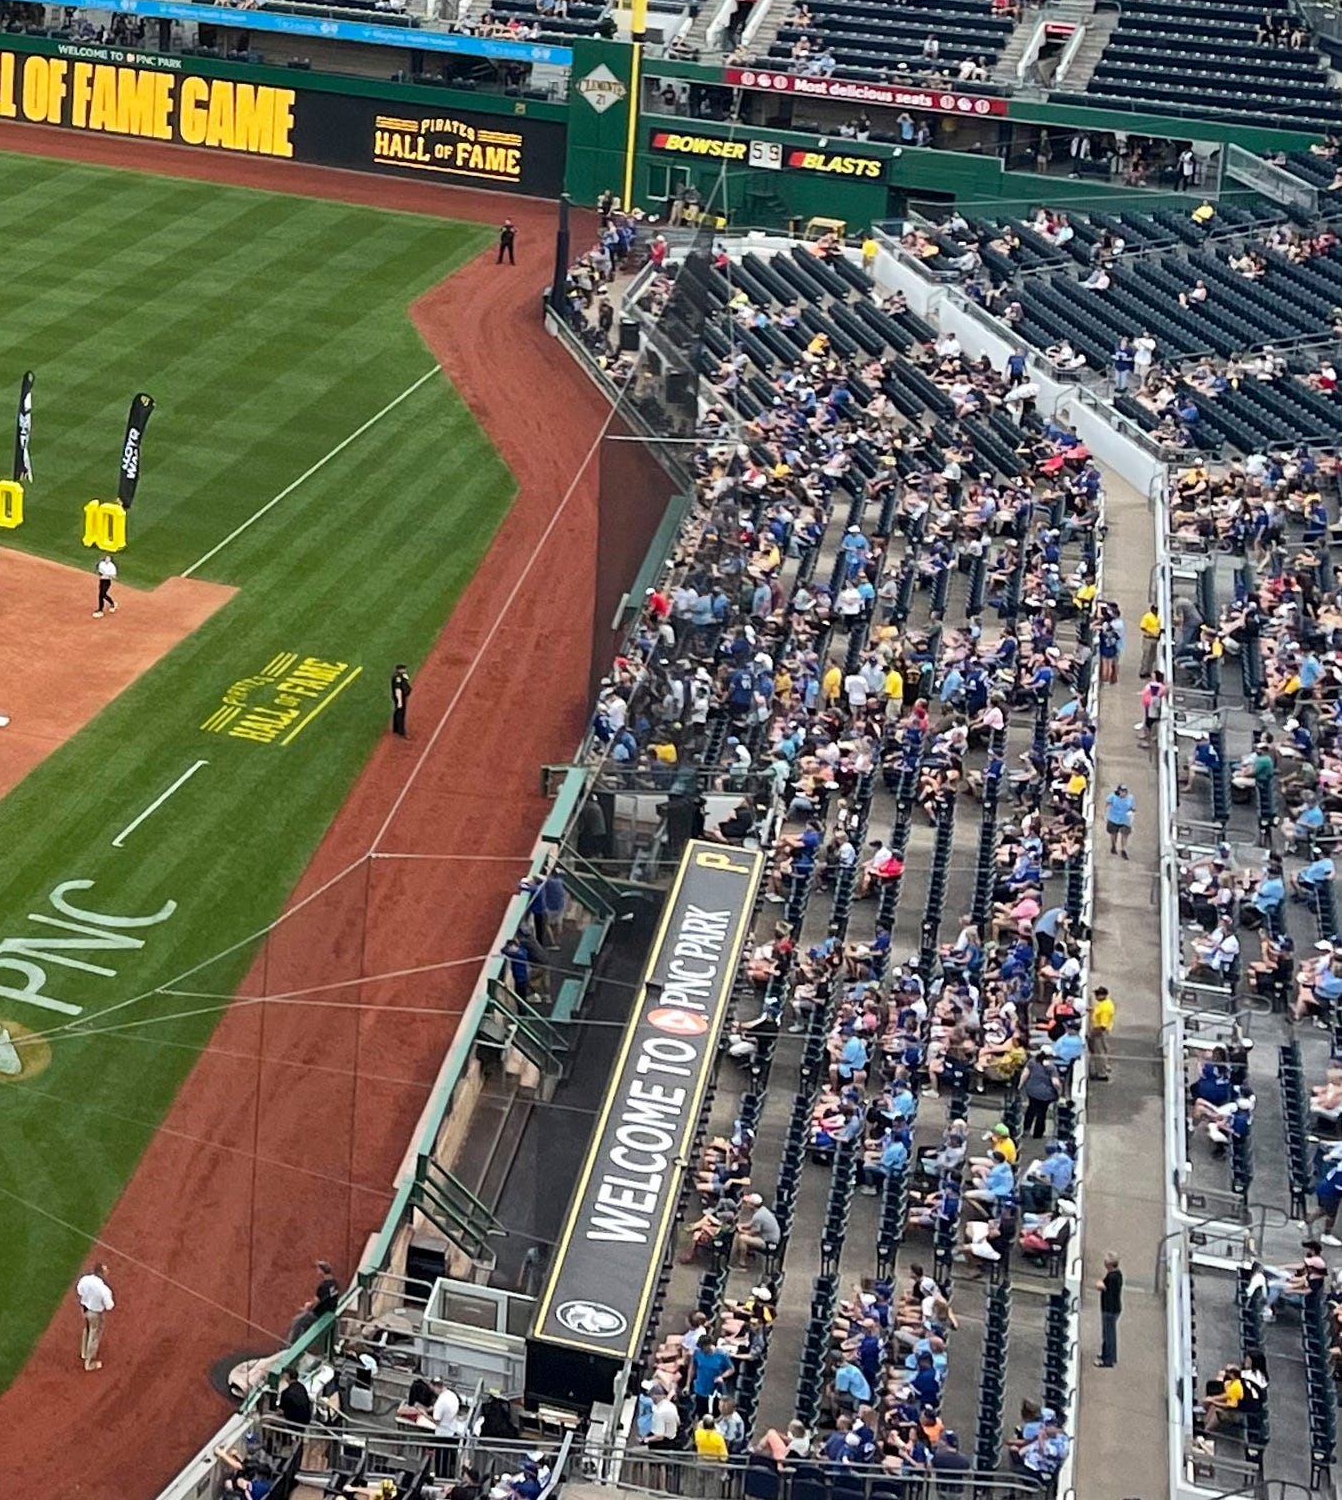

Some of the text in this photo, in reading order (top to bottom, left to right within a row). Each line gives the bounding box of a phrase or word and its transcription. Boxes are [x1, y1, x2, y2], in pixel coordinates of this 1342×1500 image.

[58, 44, 109, 60] WELCOME
[110, 50, 124, 61] TO
[22, 55, 68, 125] OF
[72, 61, 175, 140] FAME
[179, 76, 296, 158] GAME
[795, 78, 934, 108] Most delicious seats
[374, 130, 521, 175] HALL OF FAME
[419, 118, 475, 142] PIRATES
[665, 133, 747, 160] BOWSER
[802, 151, 882, 178] BLASTS
[82, 499, 127, 553] 10
[228, 706, 301, 743] HALL
[276, 657, 349, 697] FAME
[696, 851, 750, 874] P
[585, 903, 732, 1245] WELCOME TO PNC PARK
